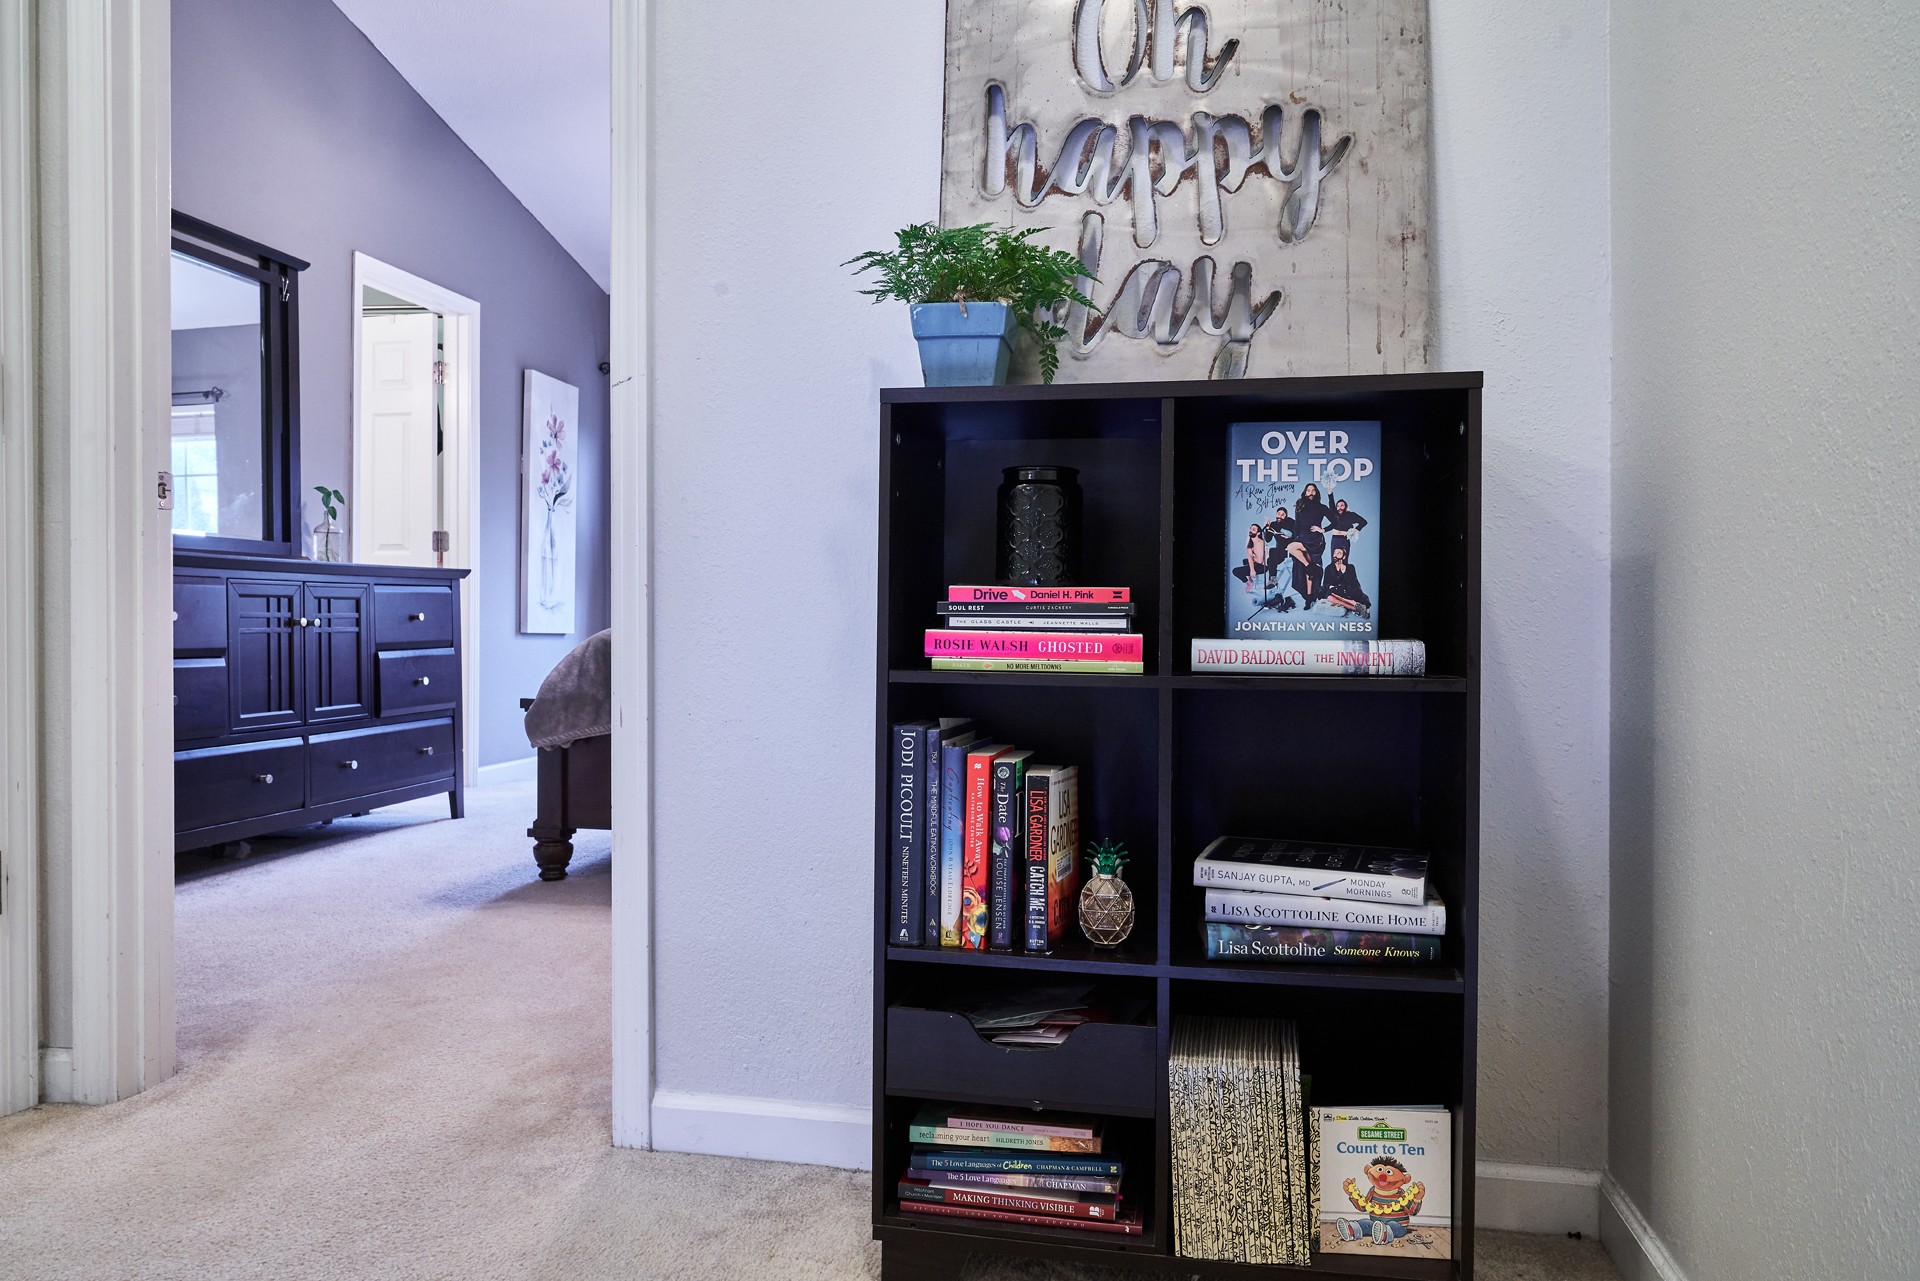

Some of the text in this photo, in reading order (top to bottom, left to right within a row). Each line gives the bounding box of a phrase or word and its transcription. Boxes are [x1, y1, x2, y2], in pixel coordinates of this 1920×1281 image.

[1072, 0, 1239, 92] Oh
[981, 80, 1355, 248] happy
[1261, 430, 1349, 455] OVER
[1236, 457, 1374, 483] THE TOP
[1235, 484, 1244, 501] A
[973, 588, 1094, 601] Drive Daniel H. Pink
[1234, 621, 1372, 632] JONATHAN VAN NESS
[933, 638, 1103, 654] ROSIE WALSH GHOSTED
[1006, 662, 1015, 670] NO
[1015, 662, 1030, 670] MORE
[1197, 648, 1394, 668] DAVID BALDACCI THE INNOCENT
[900, 730, 916, 768] JODI
[900, 773, 914, 843] PICOULT
[997, 793, 1009, 823] Date
[1029, 790, 1043, 812] LISA
[1058, 790, 1070, 820] LISA
[974, 778, 985, 864] How to Walk Away
[1029, 814, 1043, 861] GARDNER
[901, 846, 909, 887] NINETEEN
[929, 854, 937, 896] WORKBOOK
[996, 858, 1004, 891] LOUISE
[1217, 869, 1256, 883] SANJAY
[1258, 873, 1296, 886] GUPTA,
[1030, 866, 1045, 895] CATCH
[1350, 878, 1386, 888] MONDAY
[1029, 897, 1045, 911] ME
[1346, 888, 1392, 899] MORNINGS
[901, 888, 909, 924] MINUTES
[994, 894, 1003, 929] JENSEN
[1222, 903, 1250, 917] LISA
[1253, 905, 1339, 923] SCOTTOLINE
[1345, 911, 1384, 925] COME
[1388, 914, 1427, 927] HOME
[1218, 939, 1248, 954] Lisa
[1251, 940, 1326, 957] Scottoline
[1333, 944, 1381, 957] Someone
[1384, 946, 1420, 958] Knows
[919, 1131, 954, 1142] reclaiming
[954, 1134, 970, 1143] your
[971, 1134, 990, 1143] heart
[996, 1137, 1023, 1146] HILDRETH
[1001, 1124, 1025, 1132] DANCE
[1360, 1129, 1404, 1139] SESAME STREET
[1336, 1141, 1425, 1156] Count to Ten
[931, 1159, 943, 1167] The
[944, 1159, 949, 1167] 5
[950, 1160, 964, 1168] Love
[964, 1161, 997, 1170] Languages
[1002, 1160, 1032, 1171] Children
[960, 1173, 964, 1181] 5
[965, 1174, 983, 1182] Love
[983, 1175, 1017, 1186] Languages
[1046, 1181, 1087, 1190] CHAPMAN
[953, 1192, 990, 1205] MAKING
[991, 1196, 1038, 1210] THINKING
[1040, 1202, 1075, 1214] VISIBLE
[1044, 1219, 1086, 1228] LUCADO
